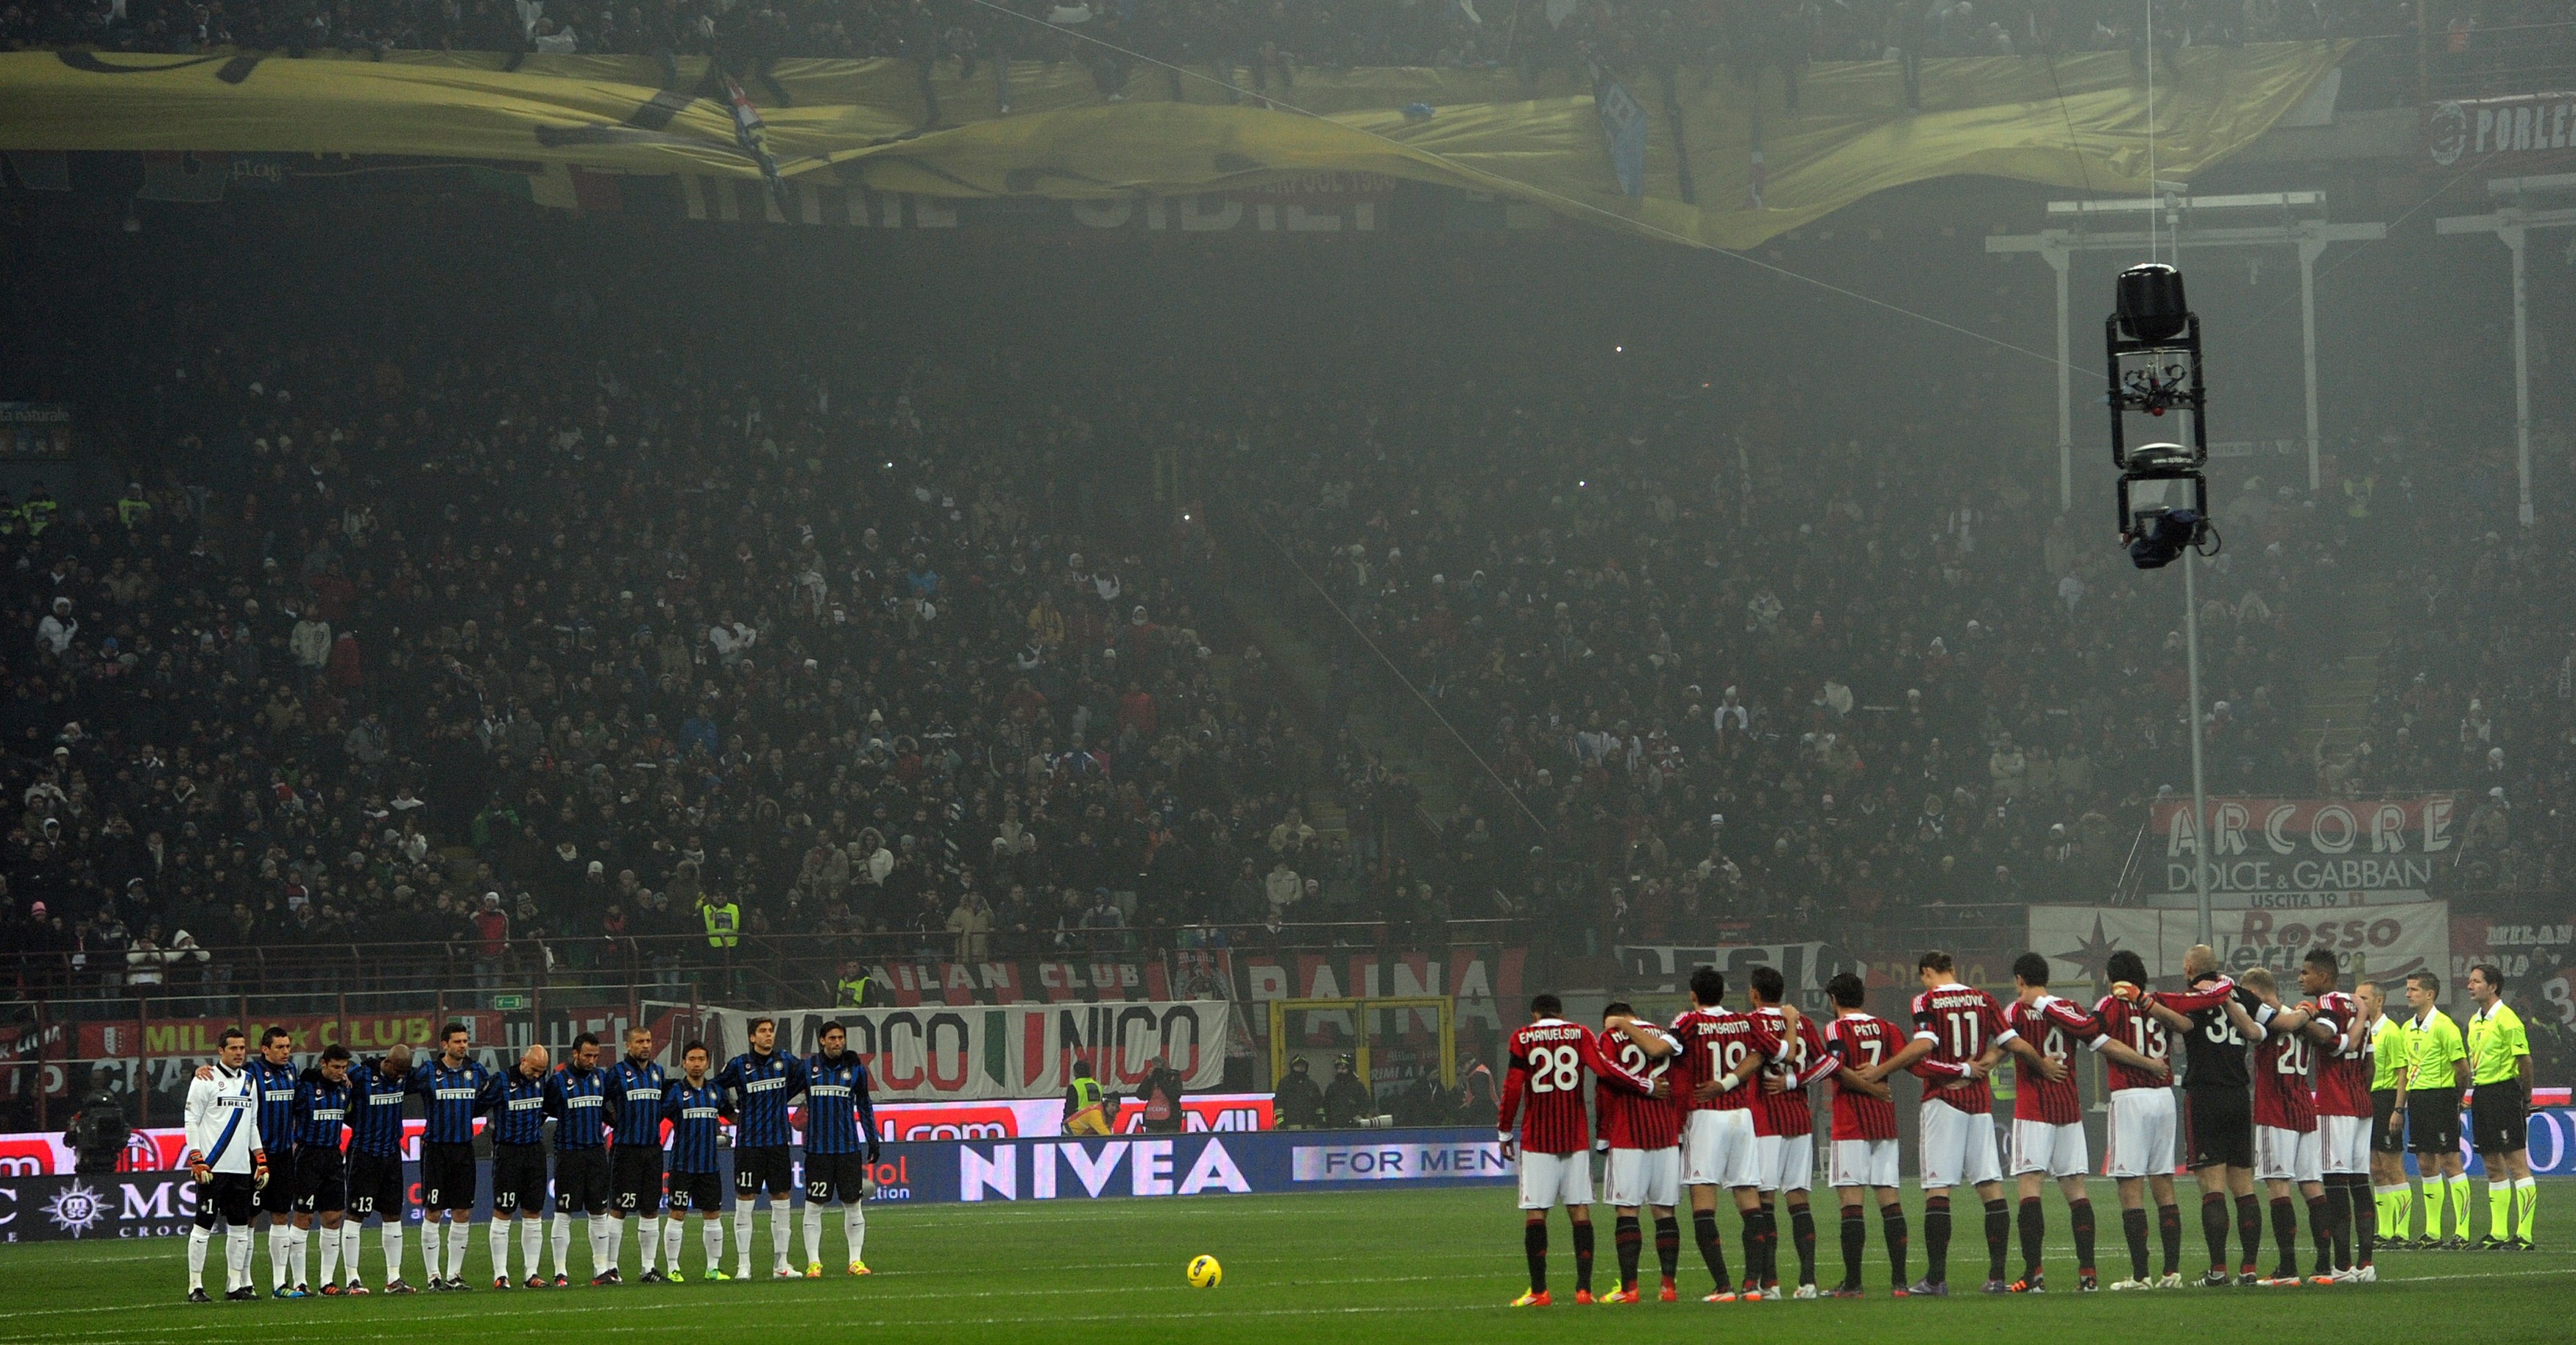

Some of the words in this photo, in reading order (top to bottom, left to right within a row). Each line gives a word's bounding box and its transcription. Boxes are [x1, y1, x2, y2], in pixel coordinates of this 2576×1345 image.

[2168, 798, 2454, 856] ARCORE
[2168, 862, 2270, 891] DOLCE
[2276, 874, 2290, 890] &
[2251, 895, 2310, 909] USCITA
[2321, 893, 2338, 907] 19
[2240, 910, 2402, 948] Rosso
[2485, 925, 2573, 945] MILAN
[868, 964, 1011, 990] MILAN
[1038, 962, 1139, 987] CLUB
[318, 1018, 431, 1048] CLUB
[1697, 1021, 1750, 1035] ZAMBROTTA
[1854, 1023, 1880, 1037] PATO
[1947, 1011, 1978, 1059] 11
[1518, 1029, 1582, 1044] EMANUELSON
[2130, 1015, 2168, 1060] 13
[1861, 1040, 1882, 1067] 7
[2043, 1026, 2067, 1065] 4
[2277, 1032, 2311, 1075] 20
[1528, 1045, 1579, 1093] 28
[746, 1076, 786, 1093] PIRELLI
[810, 1085, 851, 1097] PIRELLI
[960, 1137, 1252, 1202] NIVEA
[1326, 1151, 1404, 1174] FOR
[1421, 1149, 1505, 1171] MEN
[740, 1171, 753, 1187] 11
[431, 1189, 439, 1204] 8
[811, 1182, 827, 1197] 22
[252, 1190, 261, 1206] 6
[305, 1194, 314, 1210] 4
[358, 1196, 373, 1212] 13
[502, 1192, 515, 1207] 19
[562, 1193, 570, 1208] 7
[620, 1192, 637, 1207] 25
[673, 1190, 689, 1206] 55
[207, 1199, 214, 1214] 1
